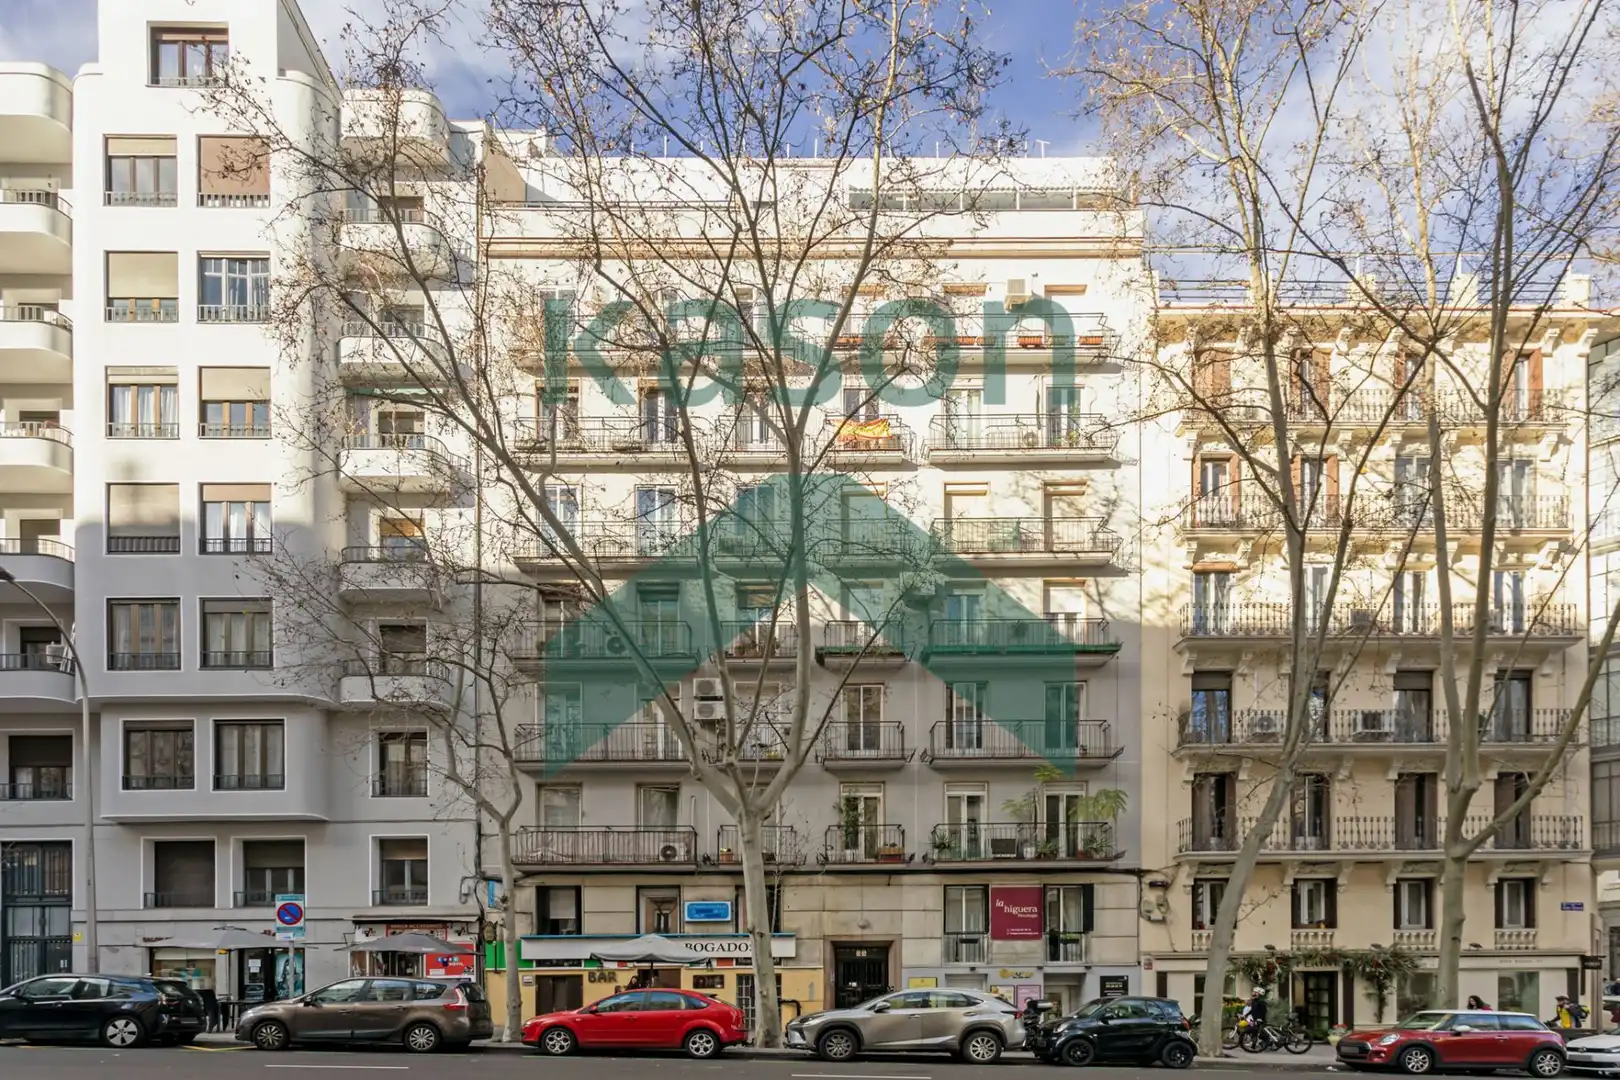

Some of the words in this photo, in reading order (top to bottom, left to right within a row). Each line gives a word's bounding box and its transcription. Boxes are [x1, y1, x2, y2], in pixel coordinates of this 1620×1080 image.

[995, 899, 1004, 907] la
[1004, 905, 1038, 915] higuera
[685, 942, 752, 953] BOGADO
[588, 971, 618, 983] BAR
